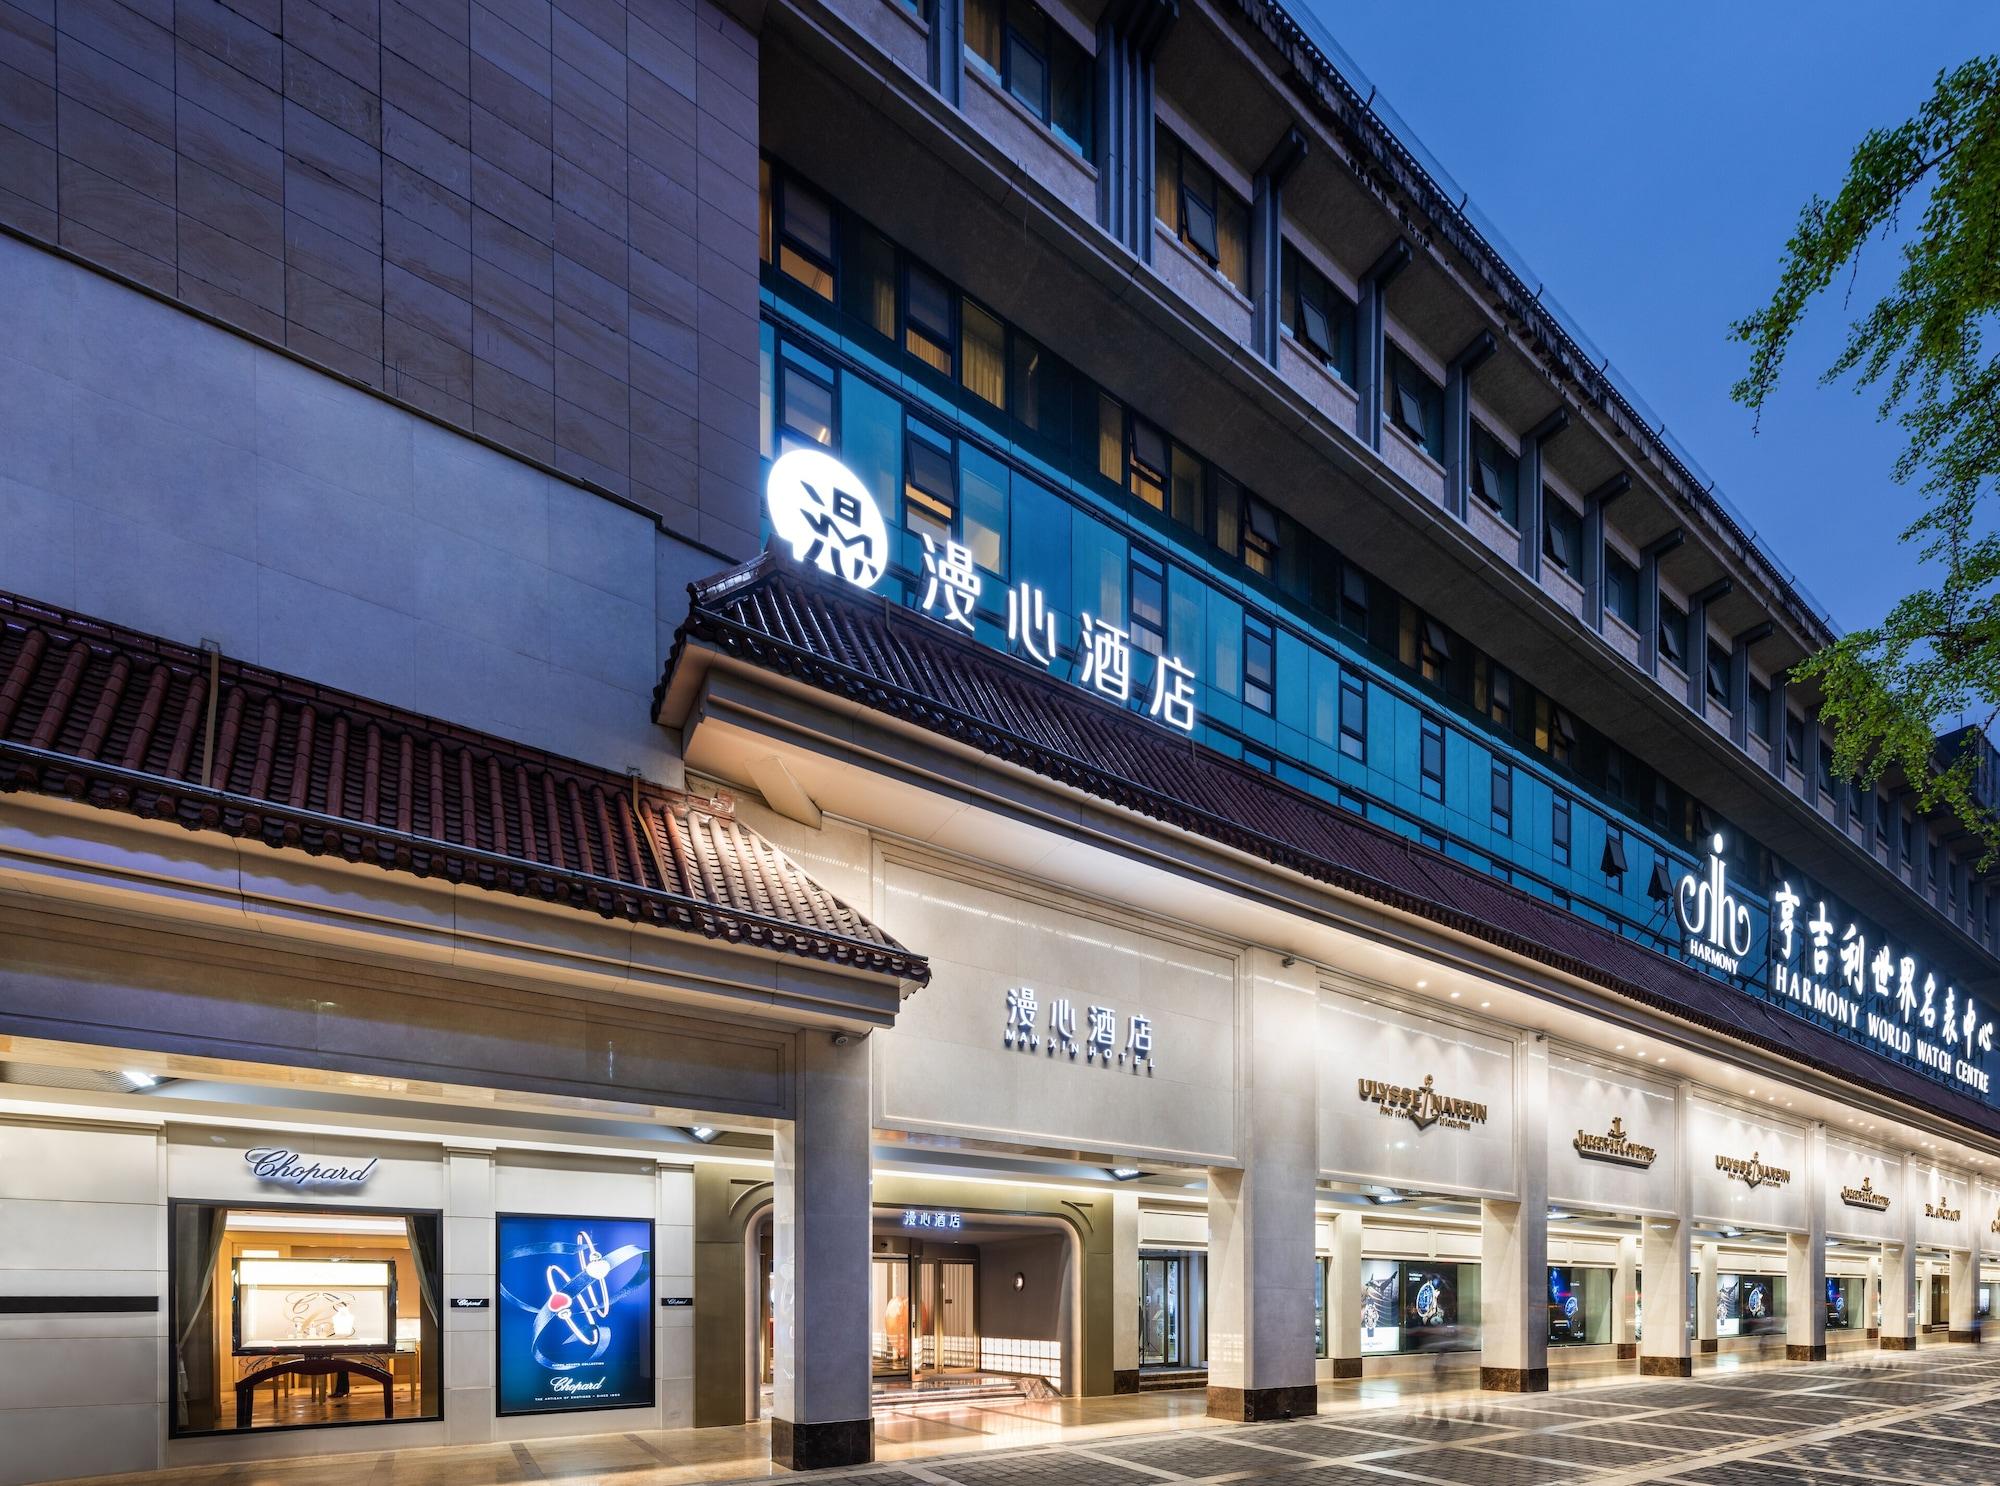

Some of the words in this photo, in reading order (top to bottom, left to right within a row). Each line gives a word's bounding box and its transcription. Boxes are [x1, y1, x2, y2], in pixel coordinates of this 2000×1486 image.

[921, 532, 1196, 732] 漫心酒店
[1689, 938, 1739, 975] HARMONY
[1775, 880, 1994, 1059] 亨吉利世界名表中心
[1007, 986, 1153, 1052] 漫心酒店
[1775, 963, 1859, 1029] HARMONY
[1867, 1011, 1912, 1055] WORLD
[1916, 1038, 1952, 1075] WATCH
[1955, 1058, 1990, 1094] CENTRE
[1005, 1029, 1041, 1046] MAN
[1049, 1038, 1080, 1054] XIN
[1089, 1046, 1156, 1068] HOTEL
[1358, 1078, 1422, 1110] ULYSSE
[1429, 1093, 1488, 1123] NARDIN
[244, 1147, 379, 1185] Chopard
[1715, 1155, 1753, 1176] ULYSSE
[903, 1210, 961, 1228] 漫心酒店
[550, 1376, 606, 1394] Chopard
